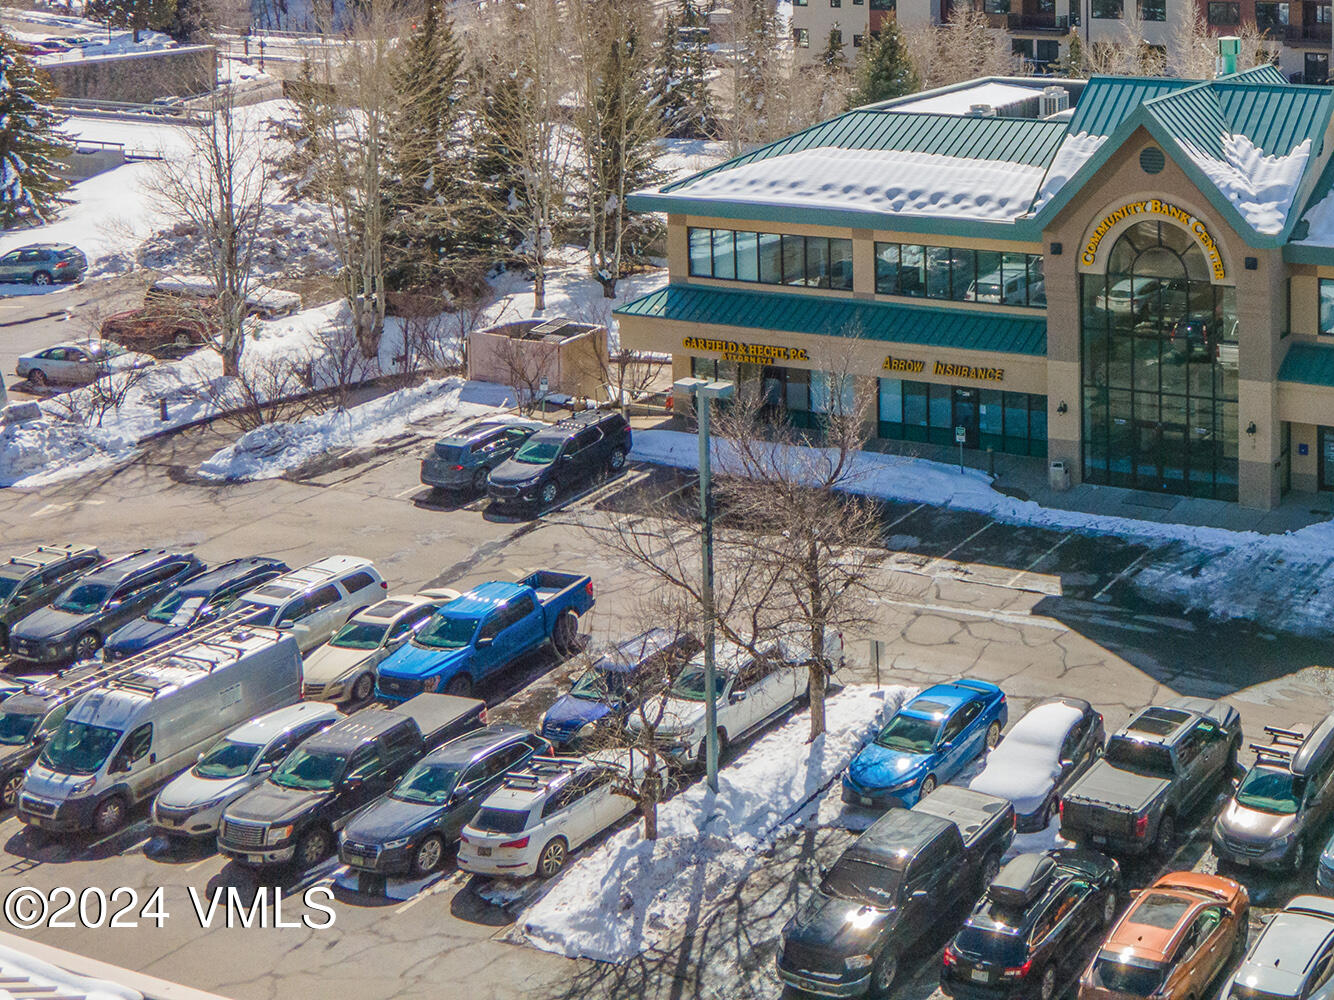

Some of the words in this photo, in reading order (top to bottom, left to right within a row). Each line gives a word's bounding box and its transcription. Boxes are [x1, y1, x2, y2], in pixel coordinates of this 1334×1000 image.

[1081, 201, 1148, 267] COMMUNITY
[1150, 199, 1191, 226] BANK
[1191, 220, 1226, 280] CENTER
[682, 336, 737, 354] GARFIELD
[738, 342, 747, 356] &
[748, 344, 789, 360] HECHT,
[789, 347, 809, 361] P.C.
[722, 352, 774, 366] ATTORNEYS
[882, 356, 925, 373] ARROW
[934, 361, 1004, 381] INSURANCE
